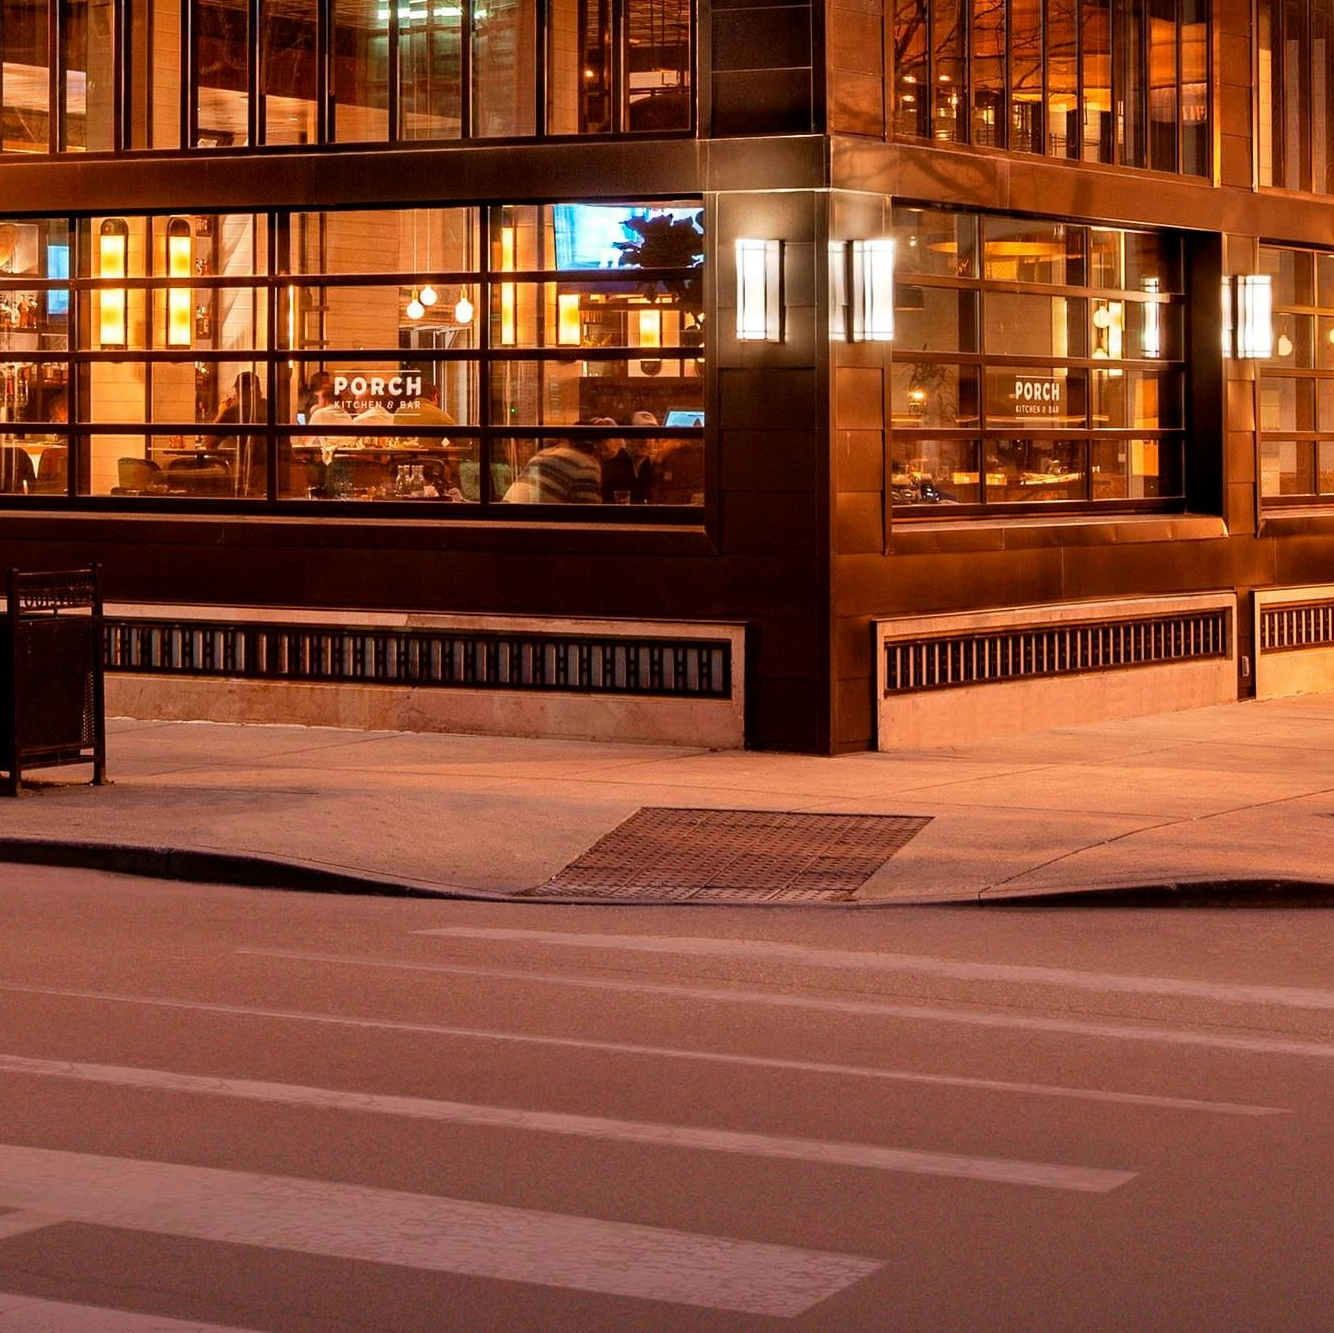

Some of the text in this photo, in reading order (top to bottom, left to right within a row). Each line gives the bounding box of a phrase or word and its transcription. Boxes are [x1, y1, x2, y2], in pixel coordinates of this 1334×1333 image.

[334, 376, 422, 396] PORCH
[1015, 381, 1060, 402] PORCH
[334, 400, 422, 410] KITCHEN & BAR
[1015, 404, 1041, 414] KITCHEN
